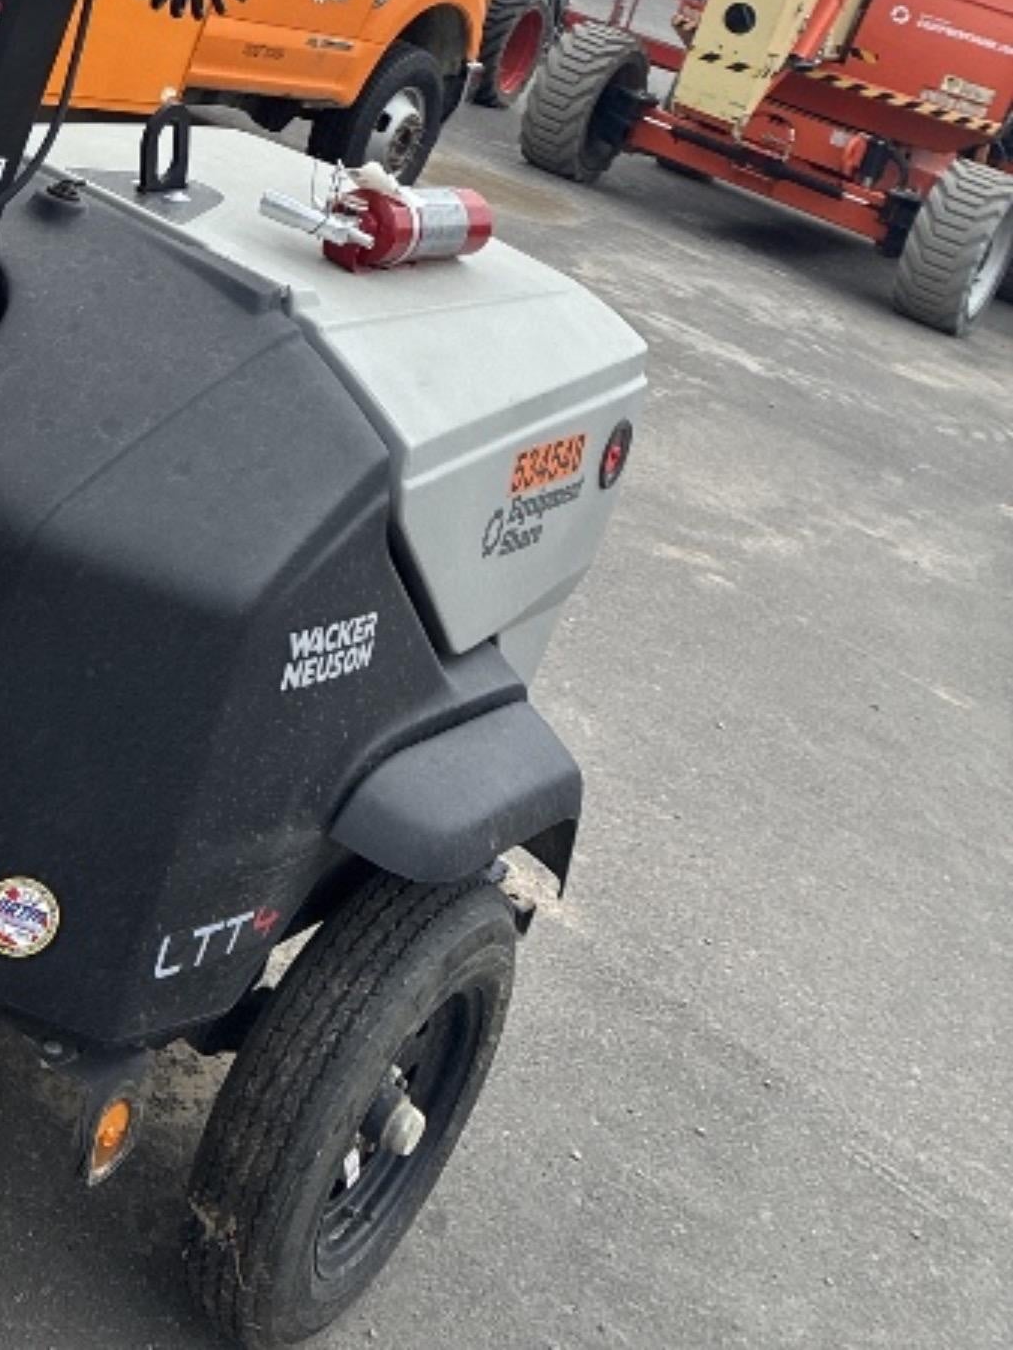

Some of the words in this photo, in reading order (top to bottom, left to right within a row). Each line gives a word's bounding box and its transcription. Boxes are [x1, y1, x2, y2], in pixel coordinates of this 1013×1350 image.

[510, 434, 586, 493] 534548
[507, 475, 585, 525] Equipment
[498, 524, 544, 556] Share
[289, 611, 379, 661] WACKER
[279, 639, 376, 692] NEUSON
